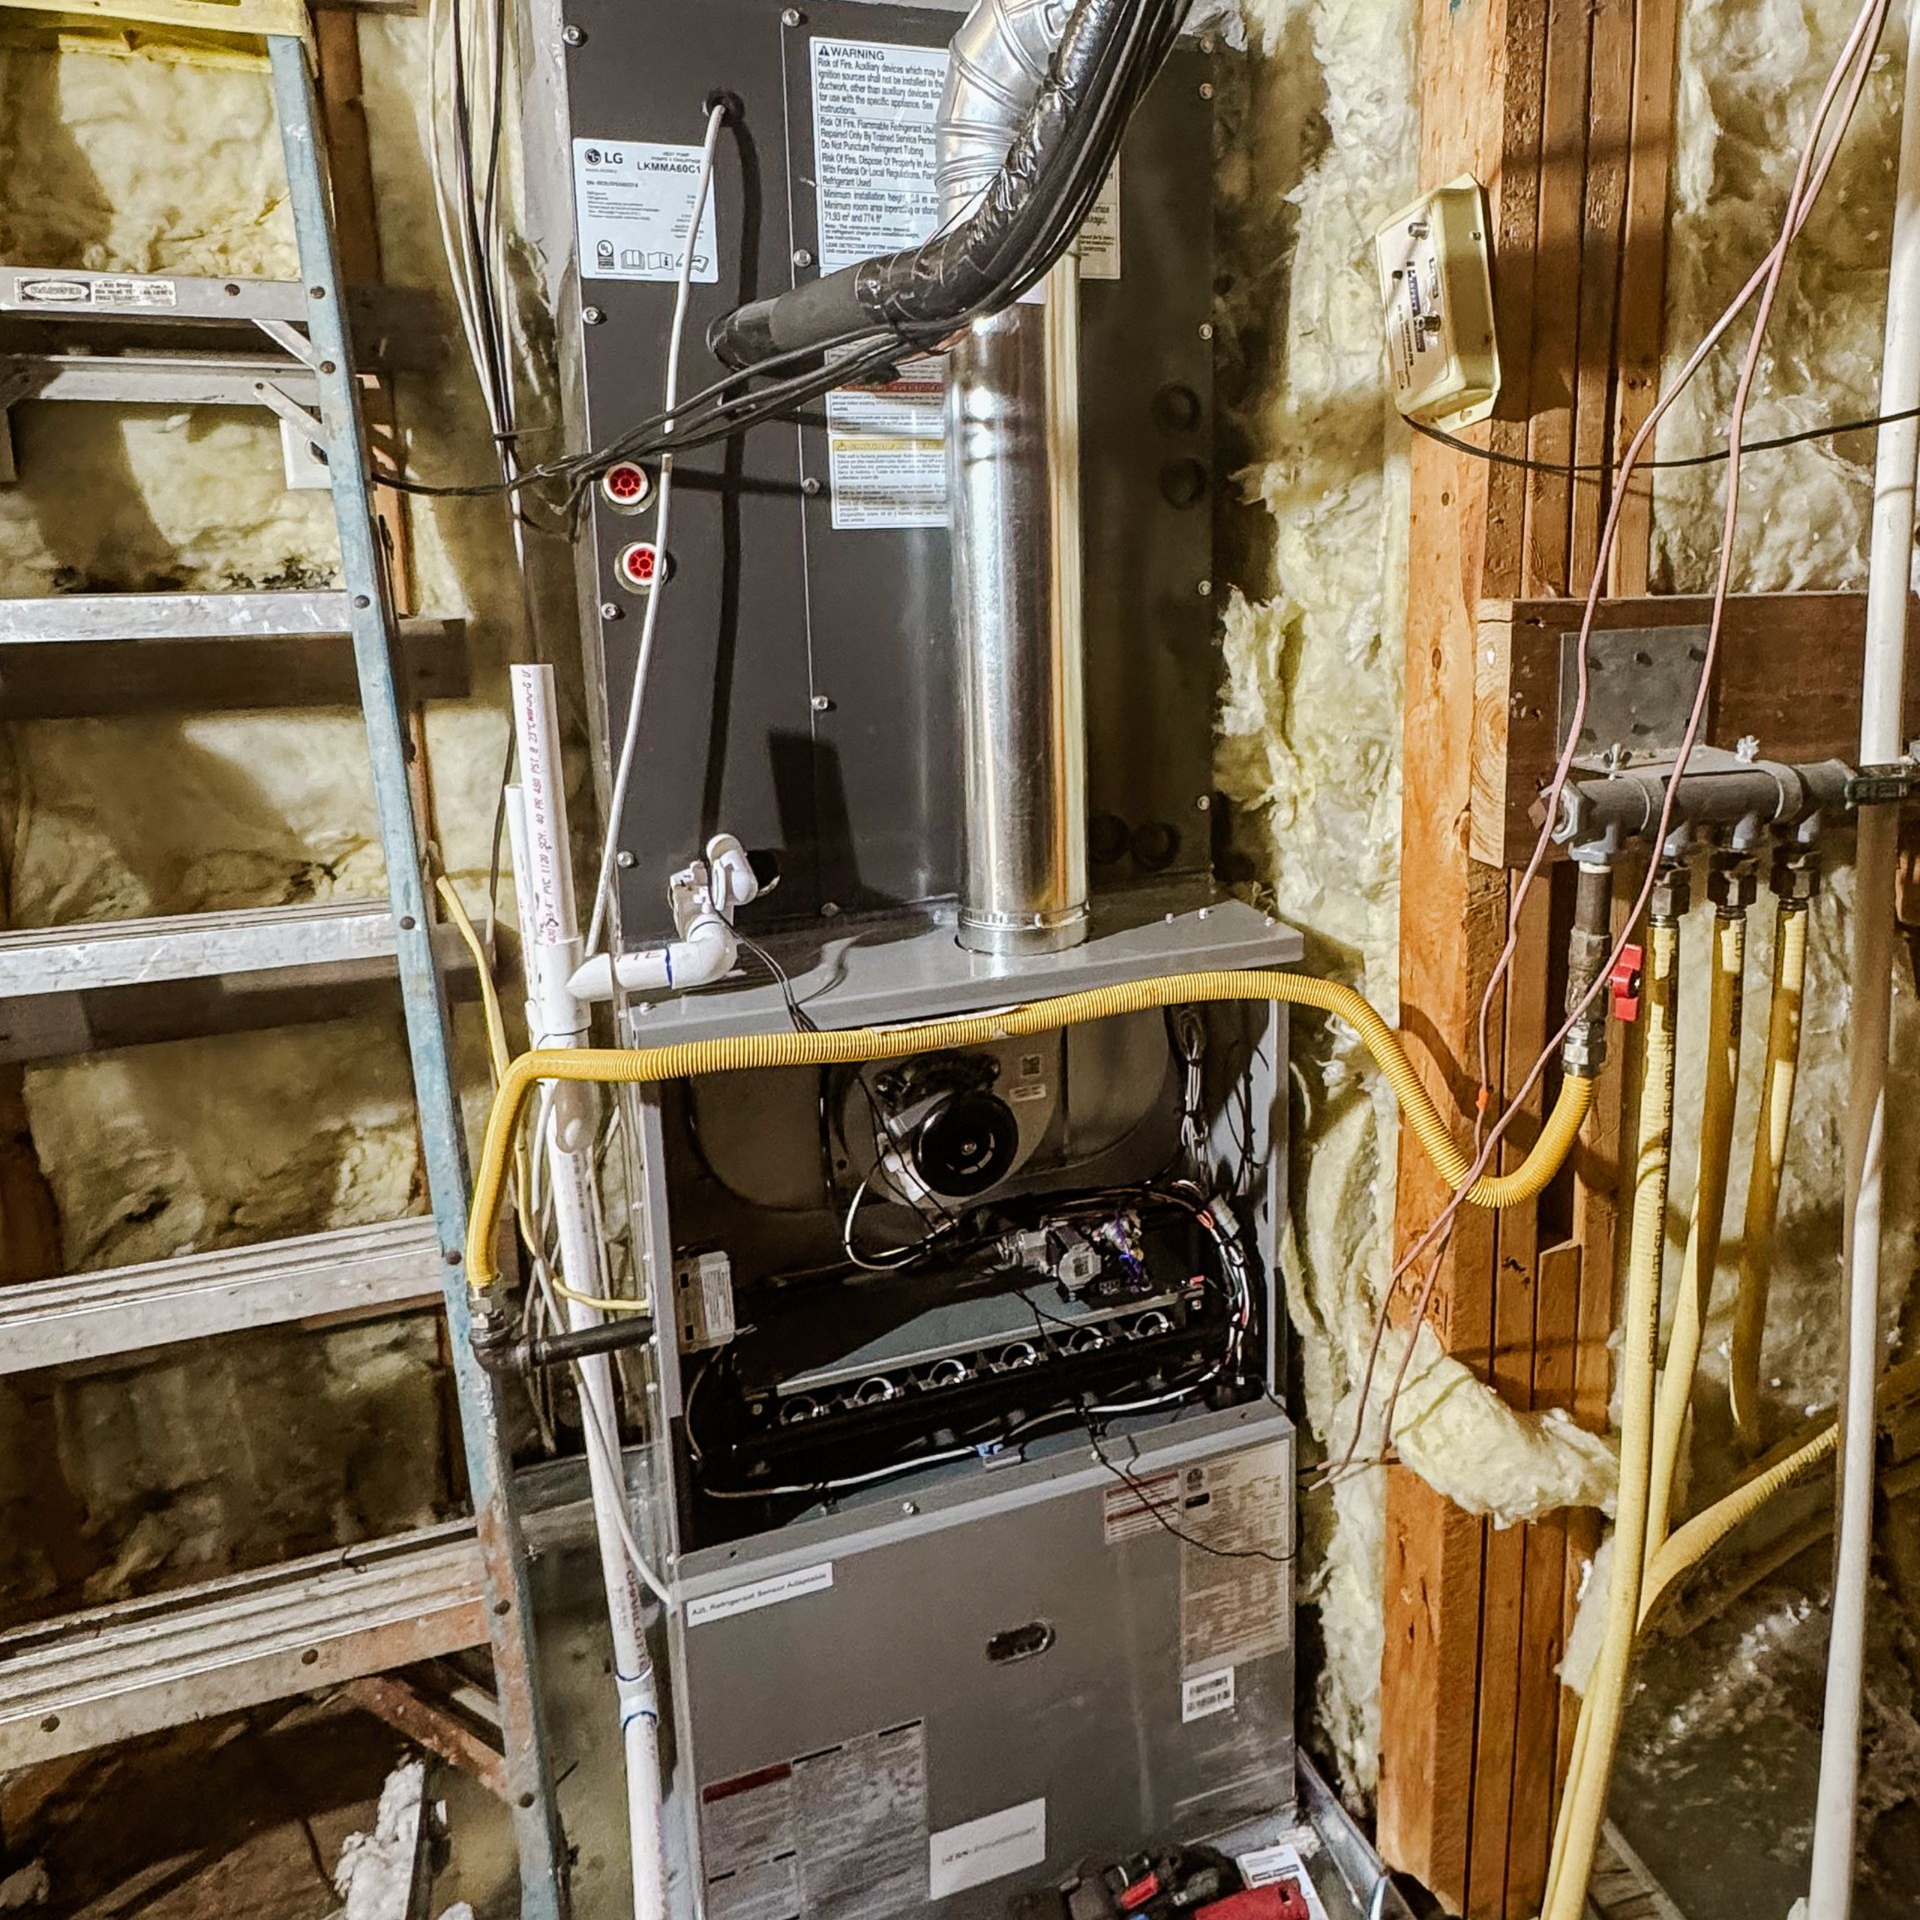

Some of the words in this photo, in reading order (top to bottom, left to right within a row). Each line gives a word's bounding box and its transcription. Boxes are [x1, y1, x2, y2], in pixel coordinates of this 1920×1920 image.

[831, 46, 884, 60] WARNING
[818, 57, 831, 67] Risk
[832, 58, 839, 68] of
[855, 61, 880, 74] Auxiliary
[881, 63, 904, 73] devices
[905, 65, 923, 75] which
[924, 68, 936, 78] may
[937, 68, 946, 77] be
[818, 69, 841, 81] ignition
[842, 73, 866, 82] sources
[867, 73, 881, 83] shall
[882, 75, 892, 84] not
[893, 76, 902, 85] be
[903, 76, 926, 87] installed
[850, 82, 866, 93] other
[867, 84, 881, 94] than
[881, 86, 906, 100] auxiliary
[907, 88, 930, 98] devices
[819, 91, 828, 101] for
[829, 94, 840, 102] use
[842, 94, 854, 104] with
[855, 95, 866, 105] the
[867, 97, 890, 108] specific
[922, 99, 934, 110] See
[820, 116, 834, 127] Risk
[835, 117, 842, 128] Of
[857, 119, 889, 131] Flammable
[890, 122, 922, 134] Refrigerant
[820, 128, 848, 140] Repaired
[848, 130, 863, 142] Only
[863, 131, 872, 142] By
[872, 131, 895, 143] Trained
[895, 133, 917, 144] Service
[821, 139, 831, 150] Do
[831, 140, 842, 150] Not
[843, 141, 870, 152] Puncture
[871, 143, 903, 156] Refrigerant
[604, 152, 623, 164] LG
[822, 152, 835, 163] Risk
[836, 153, 844, 164] Of
[858, 155, 883, 167] Dispose
[884, 156, 891, 167] Of
[892, 157, 916, 170] Properly
[637, 161, 701, 174] LKMMA60C1
[822, 164, 836, 175] With
[837, 165, 860, 176] Federal
[860, 166, 868, 177] Or
[868, 168, 885, 178] Local
[822, 175, 856, 188] Refrigerant
[856, 177, 872, 188] Used
[824, 188, 852, 199] Minimum
[854, 190, 887, 202] installation
[824, 200, 852, 211] Minimum
[853, 203, 869, 212] room
[870, 204, 883, 212] area
[914, 207, 921, 215] or
[851, 213, 863, 222] and
[864, 213, 875, 223] 774
[540, 853, 550, 873] 1120
[542, 877, 551, 894] PVC
[757, 1584, 786, 1598] Sensor
